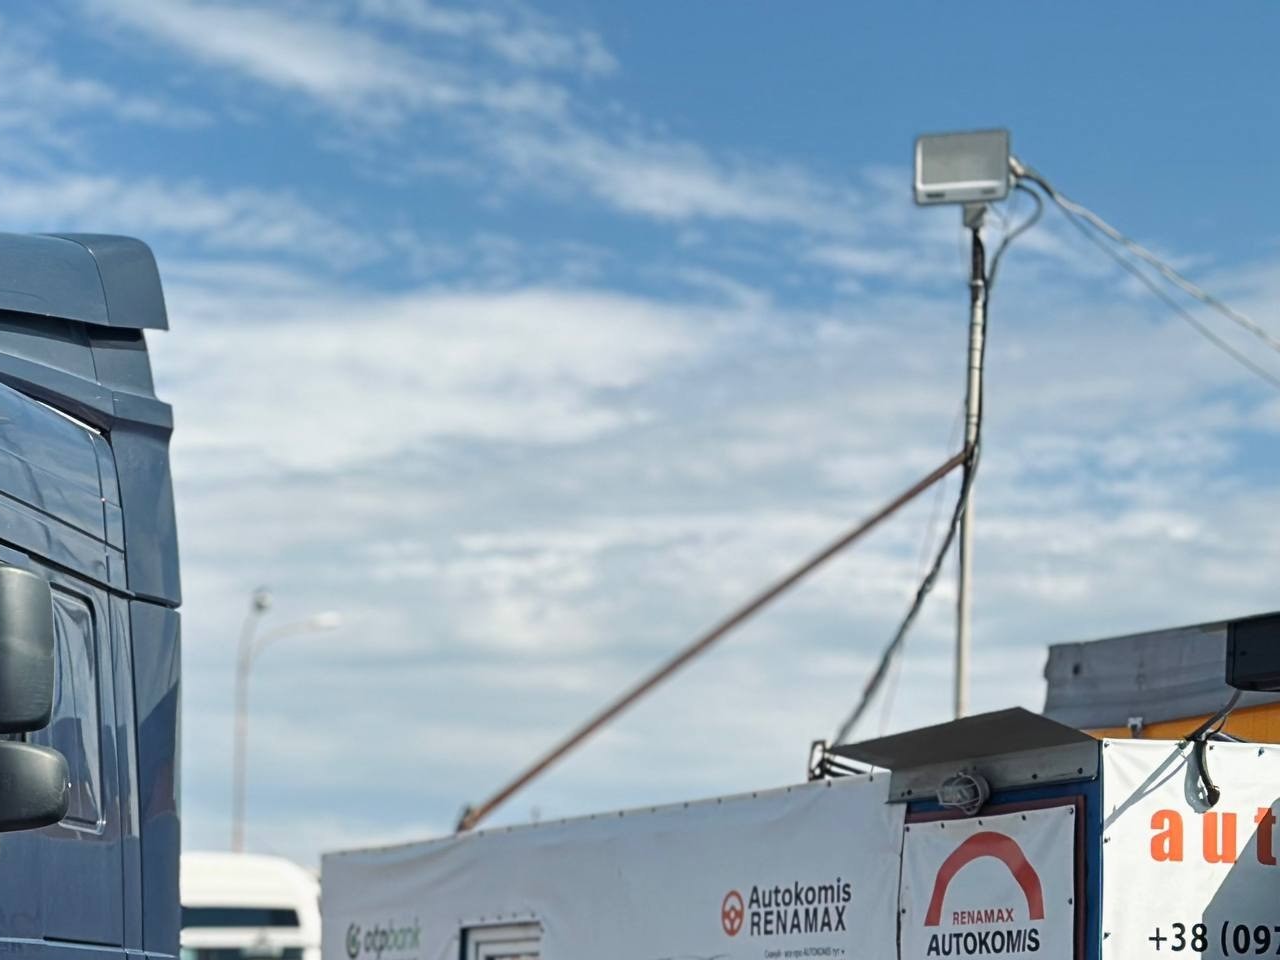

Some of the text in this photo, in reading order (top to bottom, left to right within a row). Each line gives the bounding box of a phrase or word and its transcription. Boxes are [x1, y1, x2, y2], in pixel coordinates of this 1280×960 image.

[748, 877, 852, 909] Autokomis
[750, 905, 846, 936] RENAMAX
[952, 908, 1015, 925] RENAMAX
[364, 922, 421, 960] otpbank
[927, 928, 1041, 957] AUTOKOMIS
[1148, 922, 1209, 953] +38
